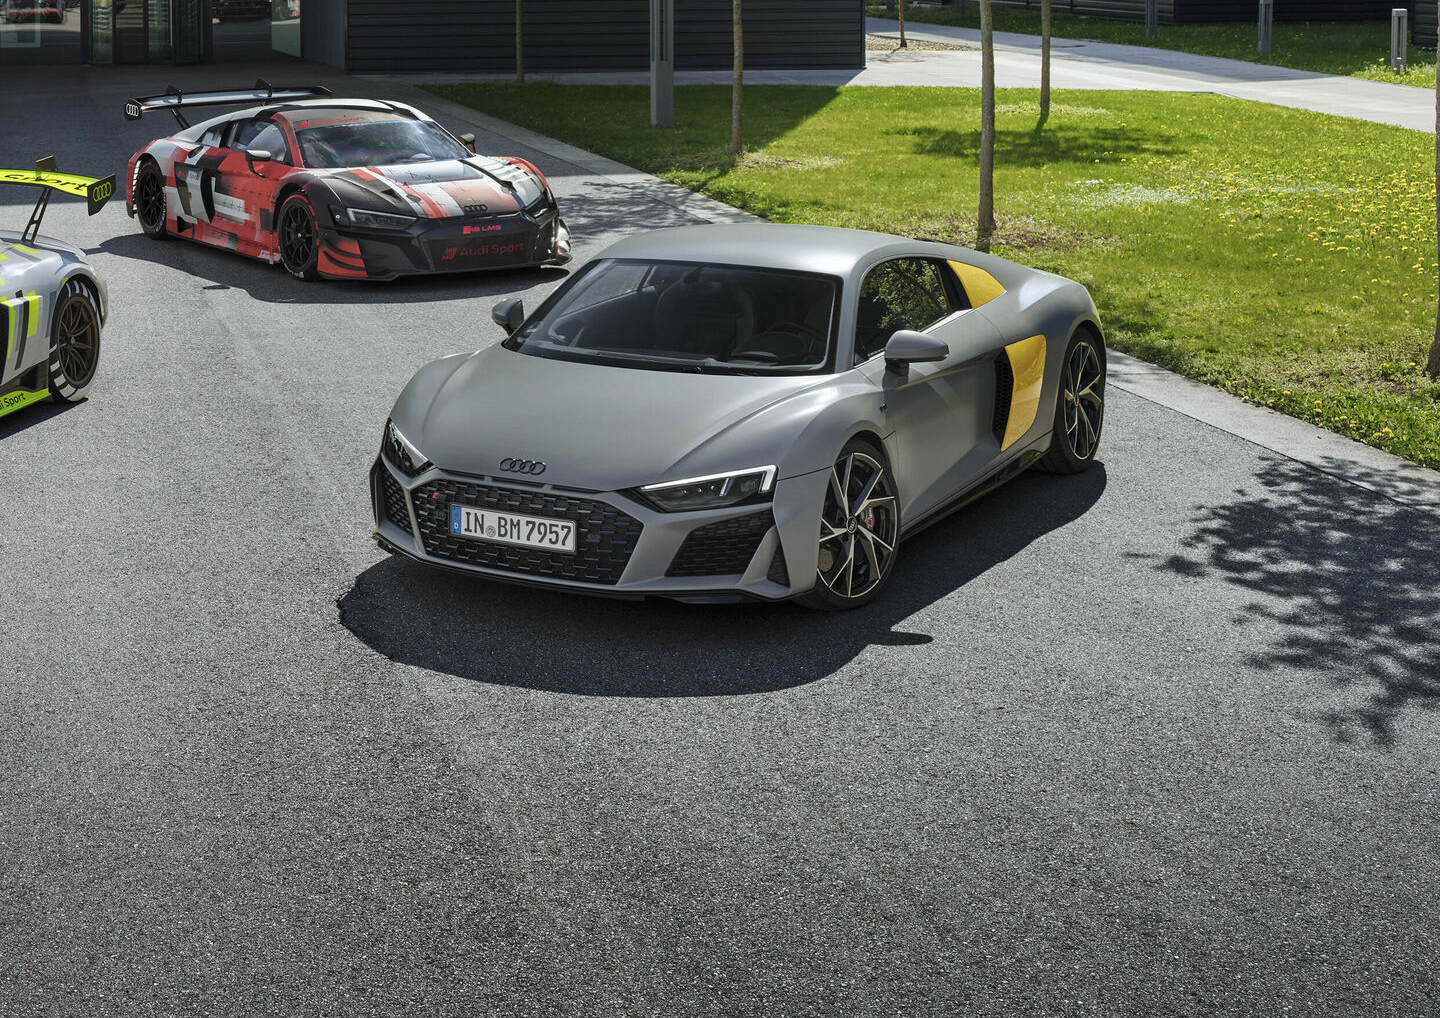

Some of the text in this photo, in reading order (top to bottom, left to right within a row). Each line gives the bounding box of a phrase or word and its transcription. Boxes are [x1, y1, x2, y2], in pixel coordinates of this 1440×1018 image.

[459, 243, 525, 256] Audi Sport
[4, 392, 26, 408] Sport
[453, 511, 572, 546] D IN BM 7957
